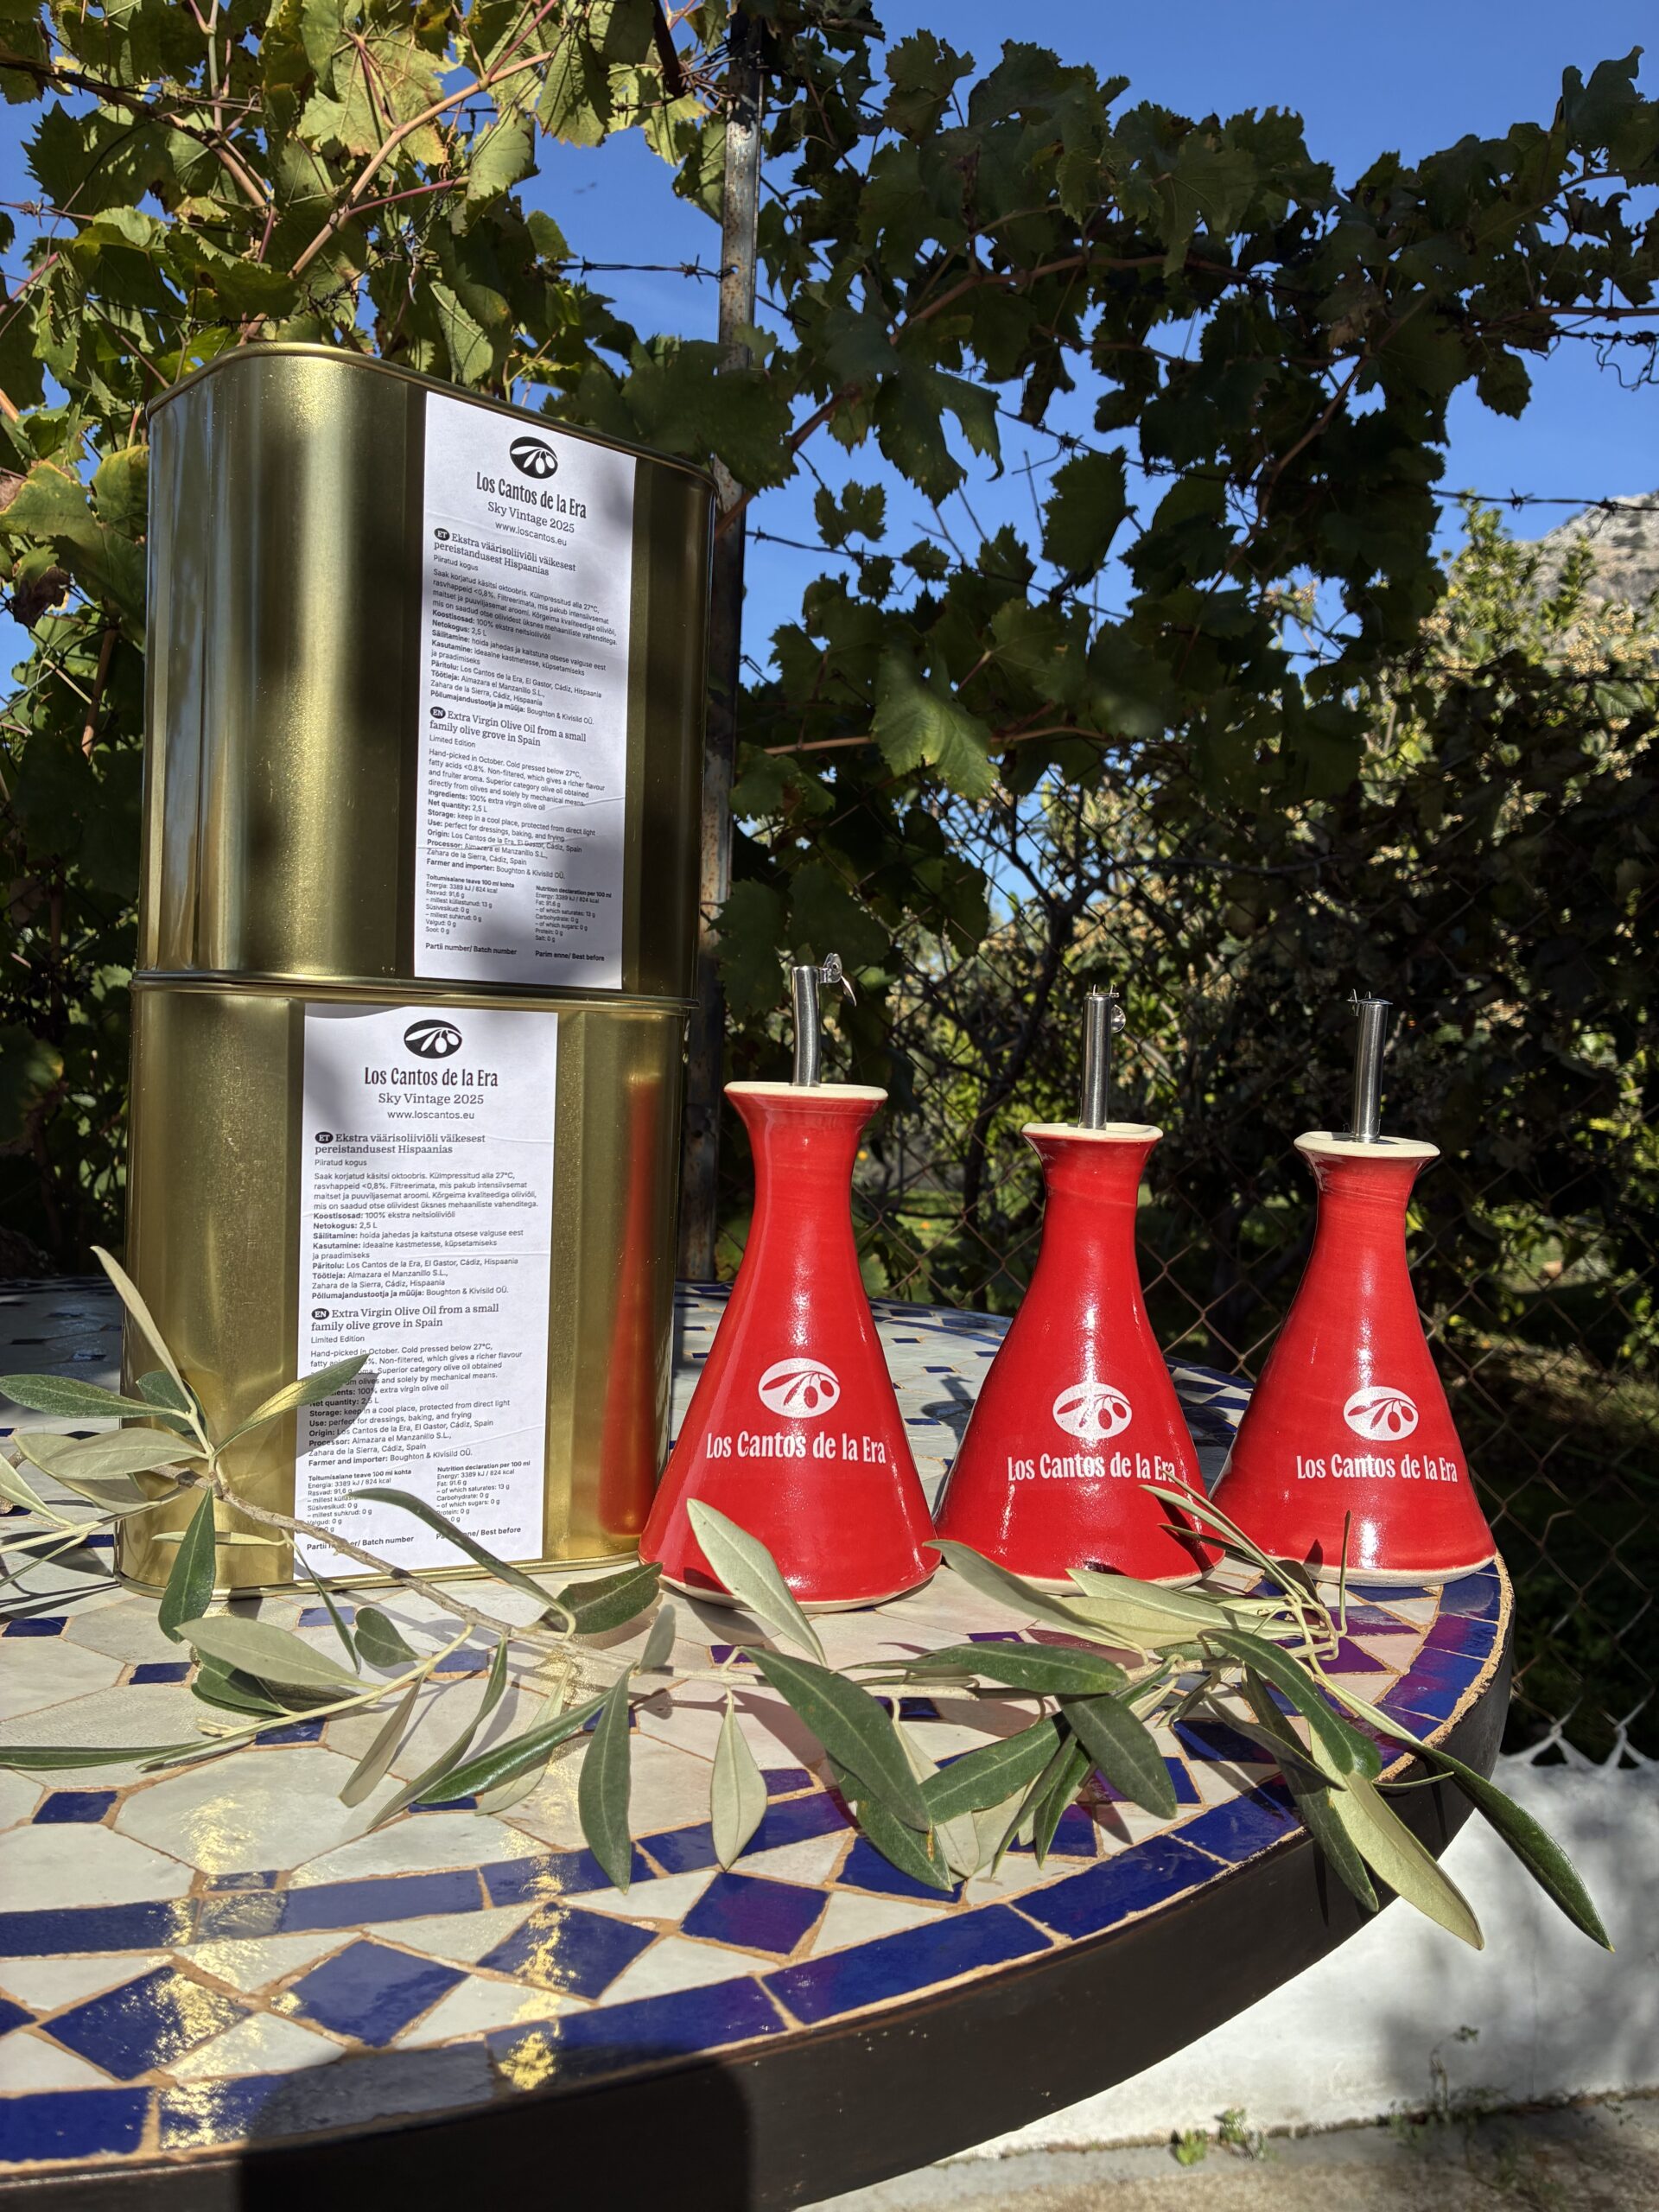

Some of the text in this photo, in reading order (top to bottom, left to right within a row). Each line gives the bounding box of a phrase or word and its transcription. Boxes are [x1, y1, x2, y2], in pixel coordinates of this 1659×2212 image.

[476, 471, 587, 518] Los Cantos de la Era
[487, 501, 575, 533] Sky Vintage 2025
[495, 522, 567, 546] www.loscantos.eu
[434, 542, 549, 576] pereistandusest Hispaanias
[451, 532, 480, 548] Ekstra
[480, 541, 537, 563] väärisoliiviõli
[538, 556, 575, 571] väikesest
[433, 554, 479, 571] Piiratud kogus
[432, 619, 470, 632] Netokogus:
[430, 679, 453, 690] Zahara
[513, 695, 543, 706] Hispaania
[429, 719, 541, 747] family olive grove in Spain
[447, 710, 471, 722] Extra
[472, 714, 499, 728] Virgin
[500, 720, 522, 731] Olive
[524, 723, 536, 734] Oil
[537, 725, 557, 737] from
[564, 732, 586, 742] small
[429, 734, 476, 748] Limited Edition
[429, 748, 470, 761] Hand-picked
[505, 760, 520, 768] Cold
[521, 764, 545, 772] pressed
[546, 766, 564, 775] below
[426, 858, 450, 867] Farmer
[496, 865, 525, 874] Boughton
[365, 1067, 498, 1087] Los Cantos de la Era
[378, 1092, 484, 1106] Sky Vintage 2025
[335, 1133, 369, 1142] Ekstra
[370, 1134, 438, 1142] väärisoliiviõli
[440, 1134, 486, 1142] väikesest
[315, 1144, 453, 1155] pereistandusest Hispaanias
[345, 1159, 367, 1167] kogus
[410, 1279, 445, 1287] Hispaania
[332, 1309, 359, 1318] Extra
[360, 1307, 392, 1318] Virgin
[394, 1306, 420, 1316] Olive
[422, 1306, 436, 1315] Oil
[438, 1305, 463, 1314] from
[473, 1303, 499, 1313] small
[311, 1318, 442, 1332] family olive grove in Spain
[328, 1417, 356, 1427] perfect
[707, 1430, 886, 1464] Los Cantos de la Era
[1007, 1452, 1175, 1484] Los Cantos de la Era
[1296, 1453, 1458, 1483] Los Cantos de la Era
